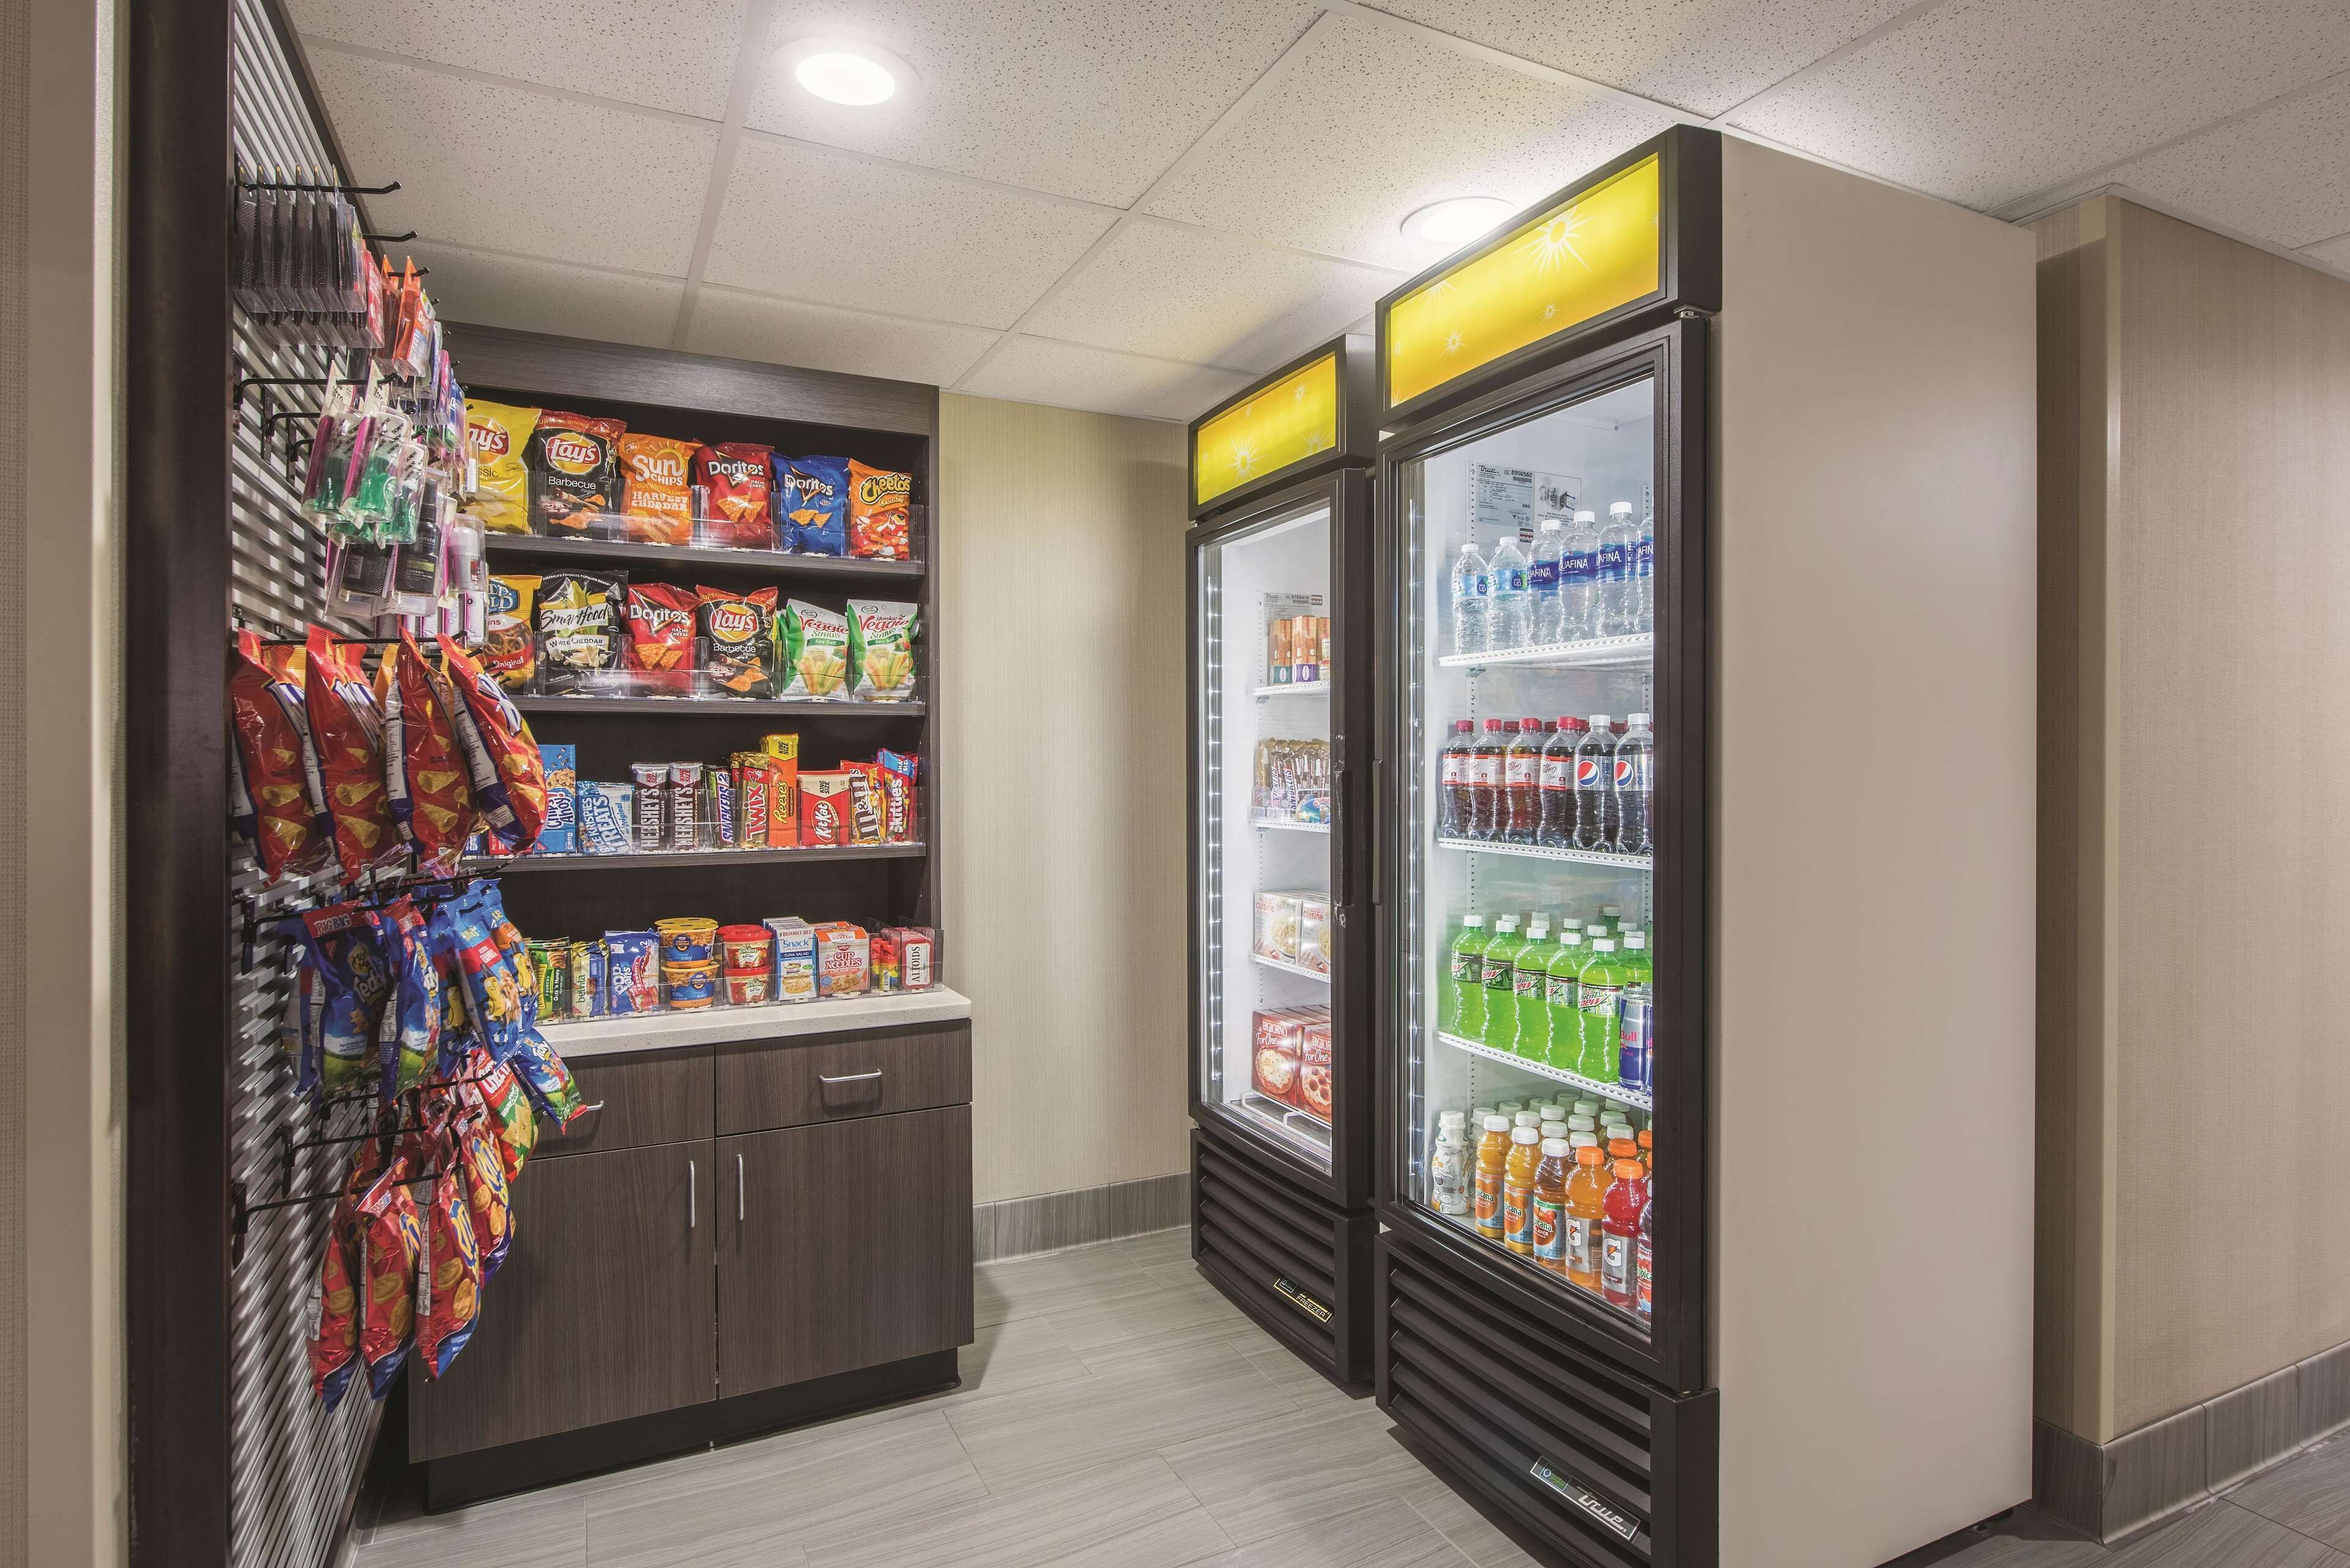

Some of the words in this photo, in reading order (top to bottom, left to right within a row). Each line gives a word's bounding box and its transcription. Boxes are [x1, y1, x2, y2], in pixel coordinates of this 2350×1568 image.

[551, 439, 597, 463] Lay's
[632, 455, 684, 481] Sun
[708, 461, 764, 477] Doritos
[548, 476, 596, 489] Barbecue
[651, 474, 683, 486] CHIPS
[784, 474, 833, 496] Doritos
[861, 475, 910, 501] Cheetos
[632, 491, 688, 503] HARVEST
[541, 605, 608, 632] Smartfood
[630, 605, 690, 624] Doritos
[799, 616, 850, 634] Veggie
[811, 630, 840, 638] Straws
[549, 638, 571, 648] WHITE
[713, 643, 756, 653] Barbecue
[615, 803, 627, 827] Original
[641, 788, 660, 847] HERSHEY'S
[675, 787, 694, 846] HERSHEY'S
[717, 784, 734, 843] SNICKERS
[593, 794, 628, 853] TREATS
[1303, 910, 1323, 921] cuisine
[315, 919, 332, 934] BIG
[783, 939, 809, 948] Snack
[825, 958, 862, 970] NOODLES
[833, 952, 855, 961] CUP
[911, 946, 921, 982] ALTOIDS
[633, 961, 644, 991] Strawberry
[1262, 1020, 1288, 1036] DIGIORNO
[1620, 1029, 1637, 1042] Bull
[1255, 1032, 1266, 1046] For
[1265, 1032, 1278, 1045] One
[1312, 1036, 1331, 1051] DIGIOR
[1304, 1048, 1315, 1062] For
[1315, 1049, 1328, 1062] One
[1603, 1237, 1622, 1267] G
[1296, 1295, 1326, 1318] FREEZER
